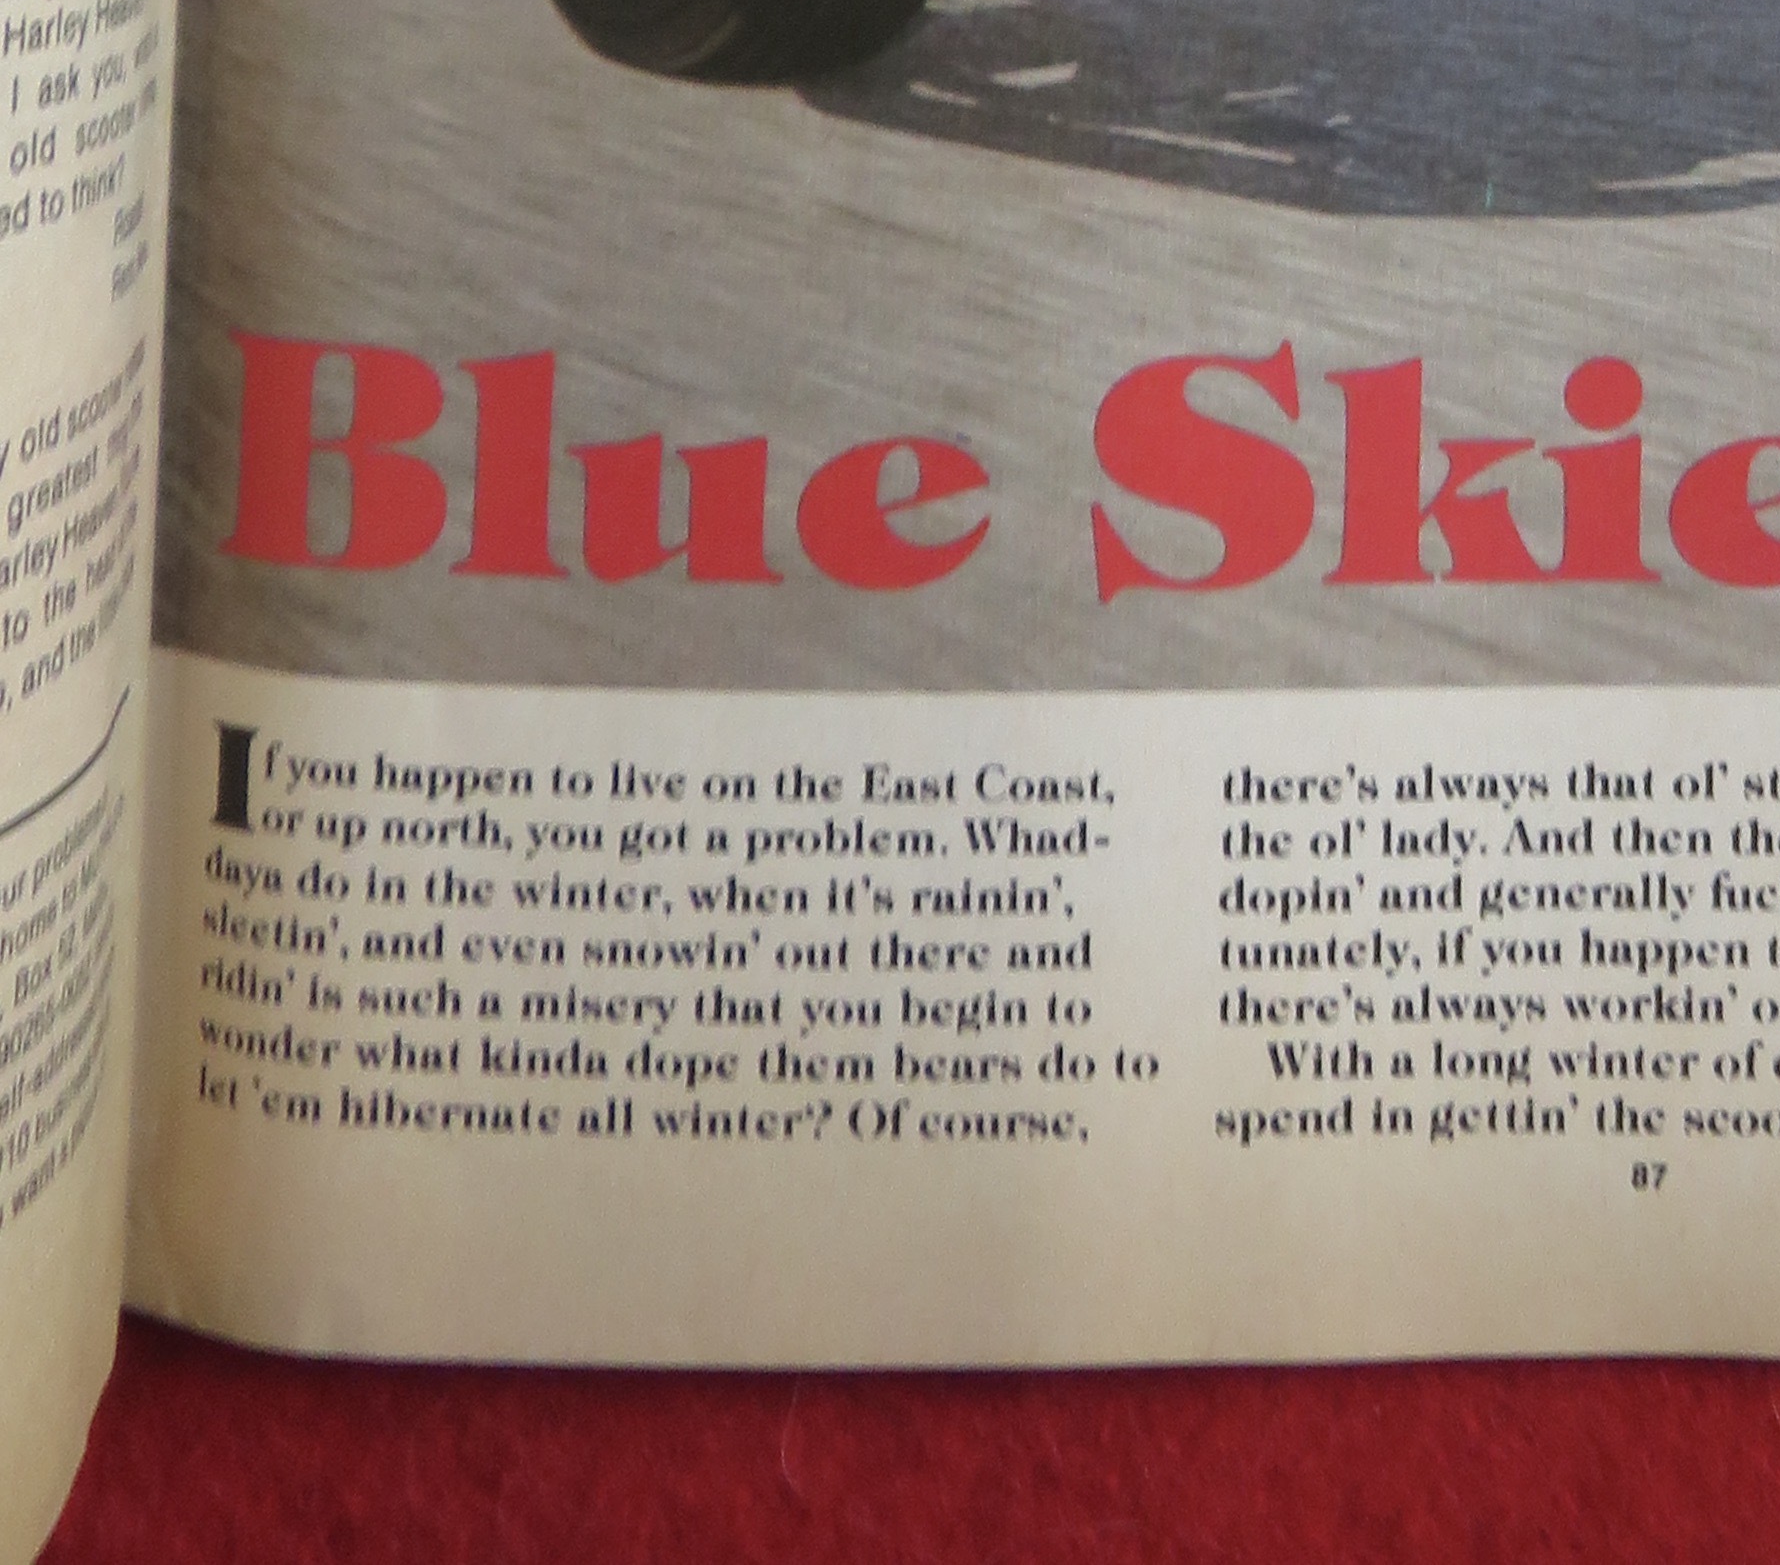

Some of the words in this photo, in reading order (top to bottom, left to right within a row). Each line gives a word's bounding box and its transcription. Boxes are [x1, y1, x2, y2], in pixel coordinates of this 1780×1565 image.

[2, 8, 90, 57] Harley
[37, 63, 81, 110] ask
[218, 331, 988, 590] Blue
[286, 756, 358, 795] you
[374, 752, 533, 803] happen
[552, 765, 594, 798] to
[610, 760, 686, 801] live
[703, 774, 756, 802] on
[776, 764, 843, 803] the
[862, 763, 956, 804] East
[975, 764, 1114, 806] Coast,
[1223, 763, 1378, 805] there's
[1395, 763, 1549, 811] always
[1568, 761, 1653, 801] that
[1673, 762, 1728, 801] ol'
[262, 807, 304, 837] or
[316, 813, 367, 853] up
[382, 808, 512, 852] north,
[526, 822, 603, 860] you
[619, 820, 689, 861] got
[706, 828, 730, 855] a
[745, 816, 947, 865] problem.
[964, 817, 1109, 856] Whad-
[1223, 820, 1292, 859] the
[1310, 817, 1366, 859] ol'
[1382, 817, 1487, 867] lady.
[1503, 816, 1593, 856] And
[1613, 816, 1712, 856] then
[205, 845, 283, 899] daya
[297, 860, 350, 902] do
[366, 866, 406, 905] in
[425, 867, 494, 908] the
[513, 871, 672, 920] winter,
[688, 873, 808, 916] when
[828, 874, 894, 915] it's
[912, 873, 1073, 920] rainin',
[1219, 873, 1364, 925] dopin'
[1379, 873, 1462, 913] and
[1479, 871, 1694, 922] generally
[203, 899, 349, 963] sleetin',
[362, 921, 444, 962] and
[462, 935, 565, 966] even
[583, 928, 760, 970] snowin'
[775, 936, 849, 972] out
[870, 931, 991, 972] there
[1007, 930, 1091, 970] and
[1268, 1039, 1373, 1080] With
[1391, 1052, 1415, 1078] a
[1433, 1039, 1531, 1087] long
[1549, 1041, 1700, 1081] winter
[1713, 1039, 1764, 1080] of
[199, 1059, 237, 1110] let
[253, 1075, 321, 1124] 'em
[340, 1086, 560, 1134] hibernate
[577, 1095, 632, 1138] all
[654, 1100, 833, 1140] winter?
[848, 1098, 909, 1142] Of
[918, 1107, 1090, 1144] course,
[1216, 1095, 1353, 1148] spend
[1372, 1097, 1413, 1134] in
[1430, 1093, 1578, 1144] gettin'
[1596, 1094, 1665, 1136] the
[1631, 1162, 1667, 1191] 87
